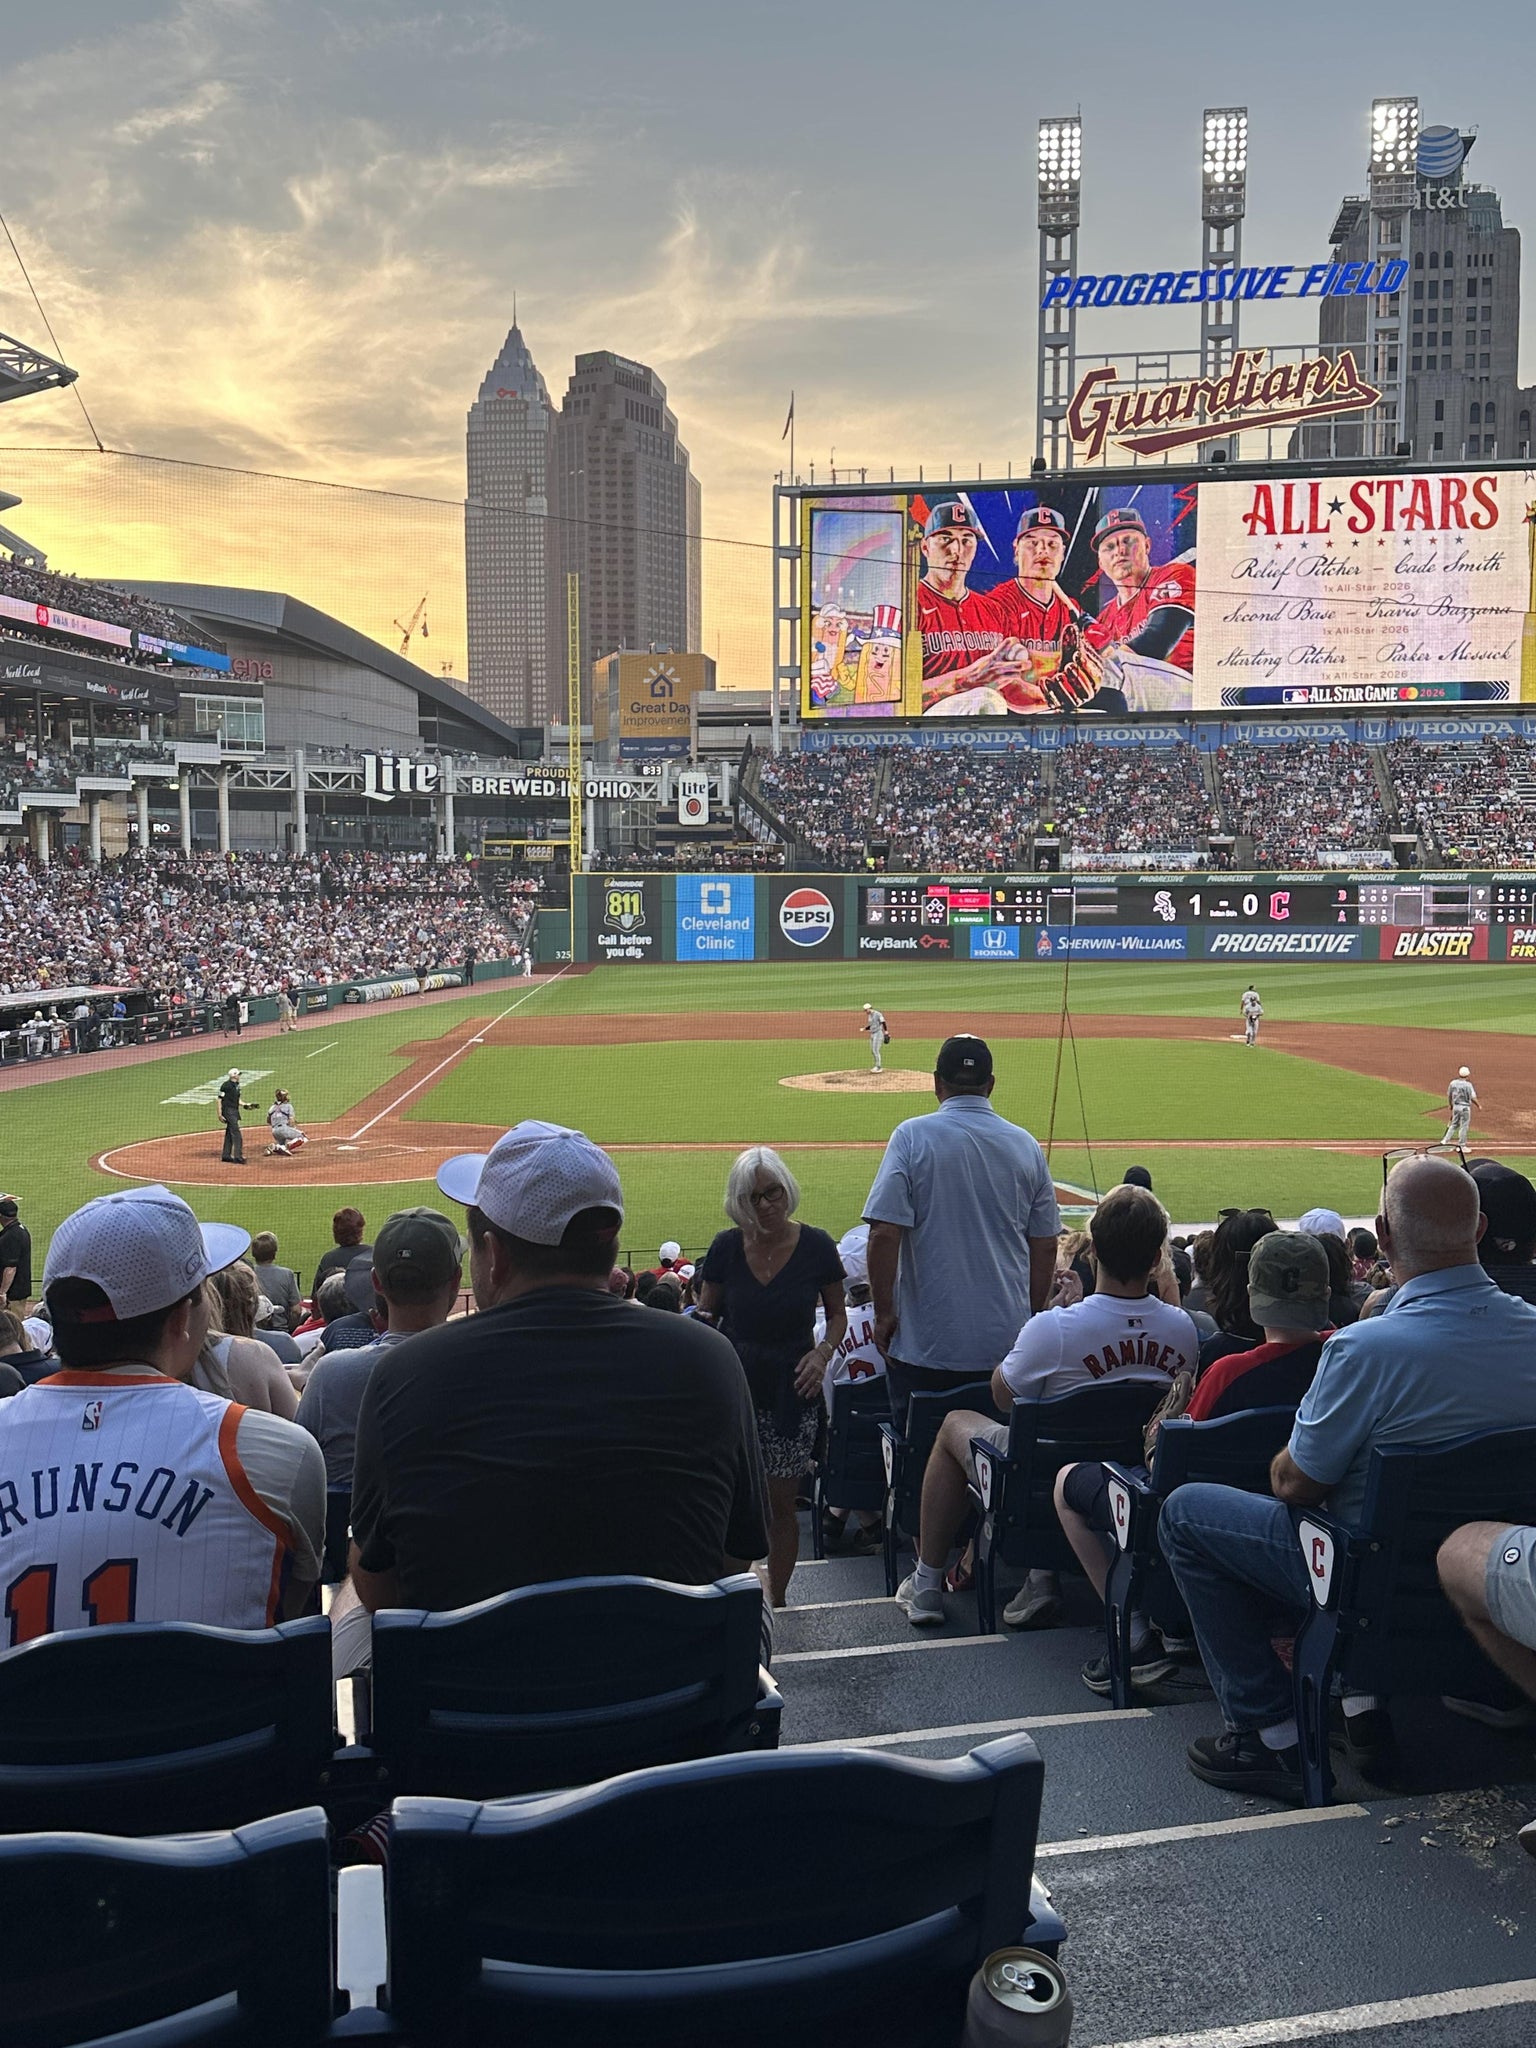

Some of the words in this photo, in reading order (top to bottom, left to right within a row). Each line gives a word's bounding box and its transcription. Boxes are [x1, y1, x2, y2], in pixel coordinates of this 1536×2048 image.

[1040, 265, 1294, 310] PROGRESSIVE
[1302, 259, 1409, 297] FIELD
[1066, 348, 1382, 465] Guardians
[1242, 481, 1331, 536] ALL
[1347, 475, 1499, 534] STARS
[1231, 557, 1294, 590] Relief
[1296, 555, 1362, 577] Pitcher
[1394, 554, 1436, 575] Cade
[1443, 551, 1505, 574] Smith
[1383, 583, 1411, 591] 2026
[1222, 602, 1283, 623] Second
[1288, 600, 1336, 621] Base
[1365, 593, 1420, 619] Travis
[1381, 626, 1409, 635] 2026
[1217, 649, 1282, 678] Starting
[1287, 645, 1347, 667] Pitcher
[1375, 641, 1430, 662] Parker
[1438, 639, 1517, 663] Messick
[1380, 671, 1408, 680] 2026
[1308, 688, 1333, 702] ALL
[1333, 688, 1365, 701] STAR
[1365, 687, 1398, 701] GAME
[1420, 688, 1445, 697] 2026
[630, 702, 666, 714] Great
[669, 702, 691, 715] Day
[623, 716, 690, 727] Improvemen
[1421, 720, 1516, 735] HONDA
[939, 730, 1028, 745] HONDA
[1095, 727, 1182, 742] HONDA
[1256, 724, 1348, 739] HONDA
[831, 732, 915, 747] HONDA
[359, 754, 439, 802] Lite
[526, 766, 579, 779] PROUDLY
[471, 777, 556, 796] BREWED
[585, 781, 632, 798] OHIO
[681, 781, 706, 797] Lite
[608, 892, 640, 916] 811
[1189, 893, 1202, 916] 1
[1243, 894, 1259, 916] 0
[1270, 891, 1290, 920] C
[682, 917, 750, 931] Cleveland
[783, 911, 831, 923] PEPSI
[598, 934, 617, 945] Call
[620, 934, 653, 945] before
[695, 936, 736, 950] Clinic
[1210, 933, 1357, 953] PROGRESSIVE
[1511, 928, 1536, 943] PH
[860, 937, 918, 951] KeyBank
[1394, 932, 1473, 956] BLASTER
[1510, 944, 1536, 958] FIR
[555, 950, 571, 960] 325
[606, 948, 625, 959] you
[974, 949, 1016, 957] HONDA
[837, 1320, 875, 1358] DeLA
[1082, 1332, 1187, 1380] RAMÍREZ
[0, 1461, 215, 1537] RUNSON
[1312, 1537, 1325, 1578] C
[5, 1557, 138, 1648] 11
